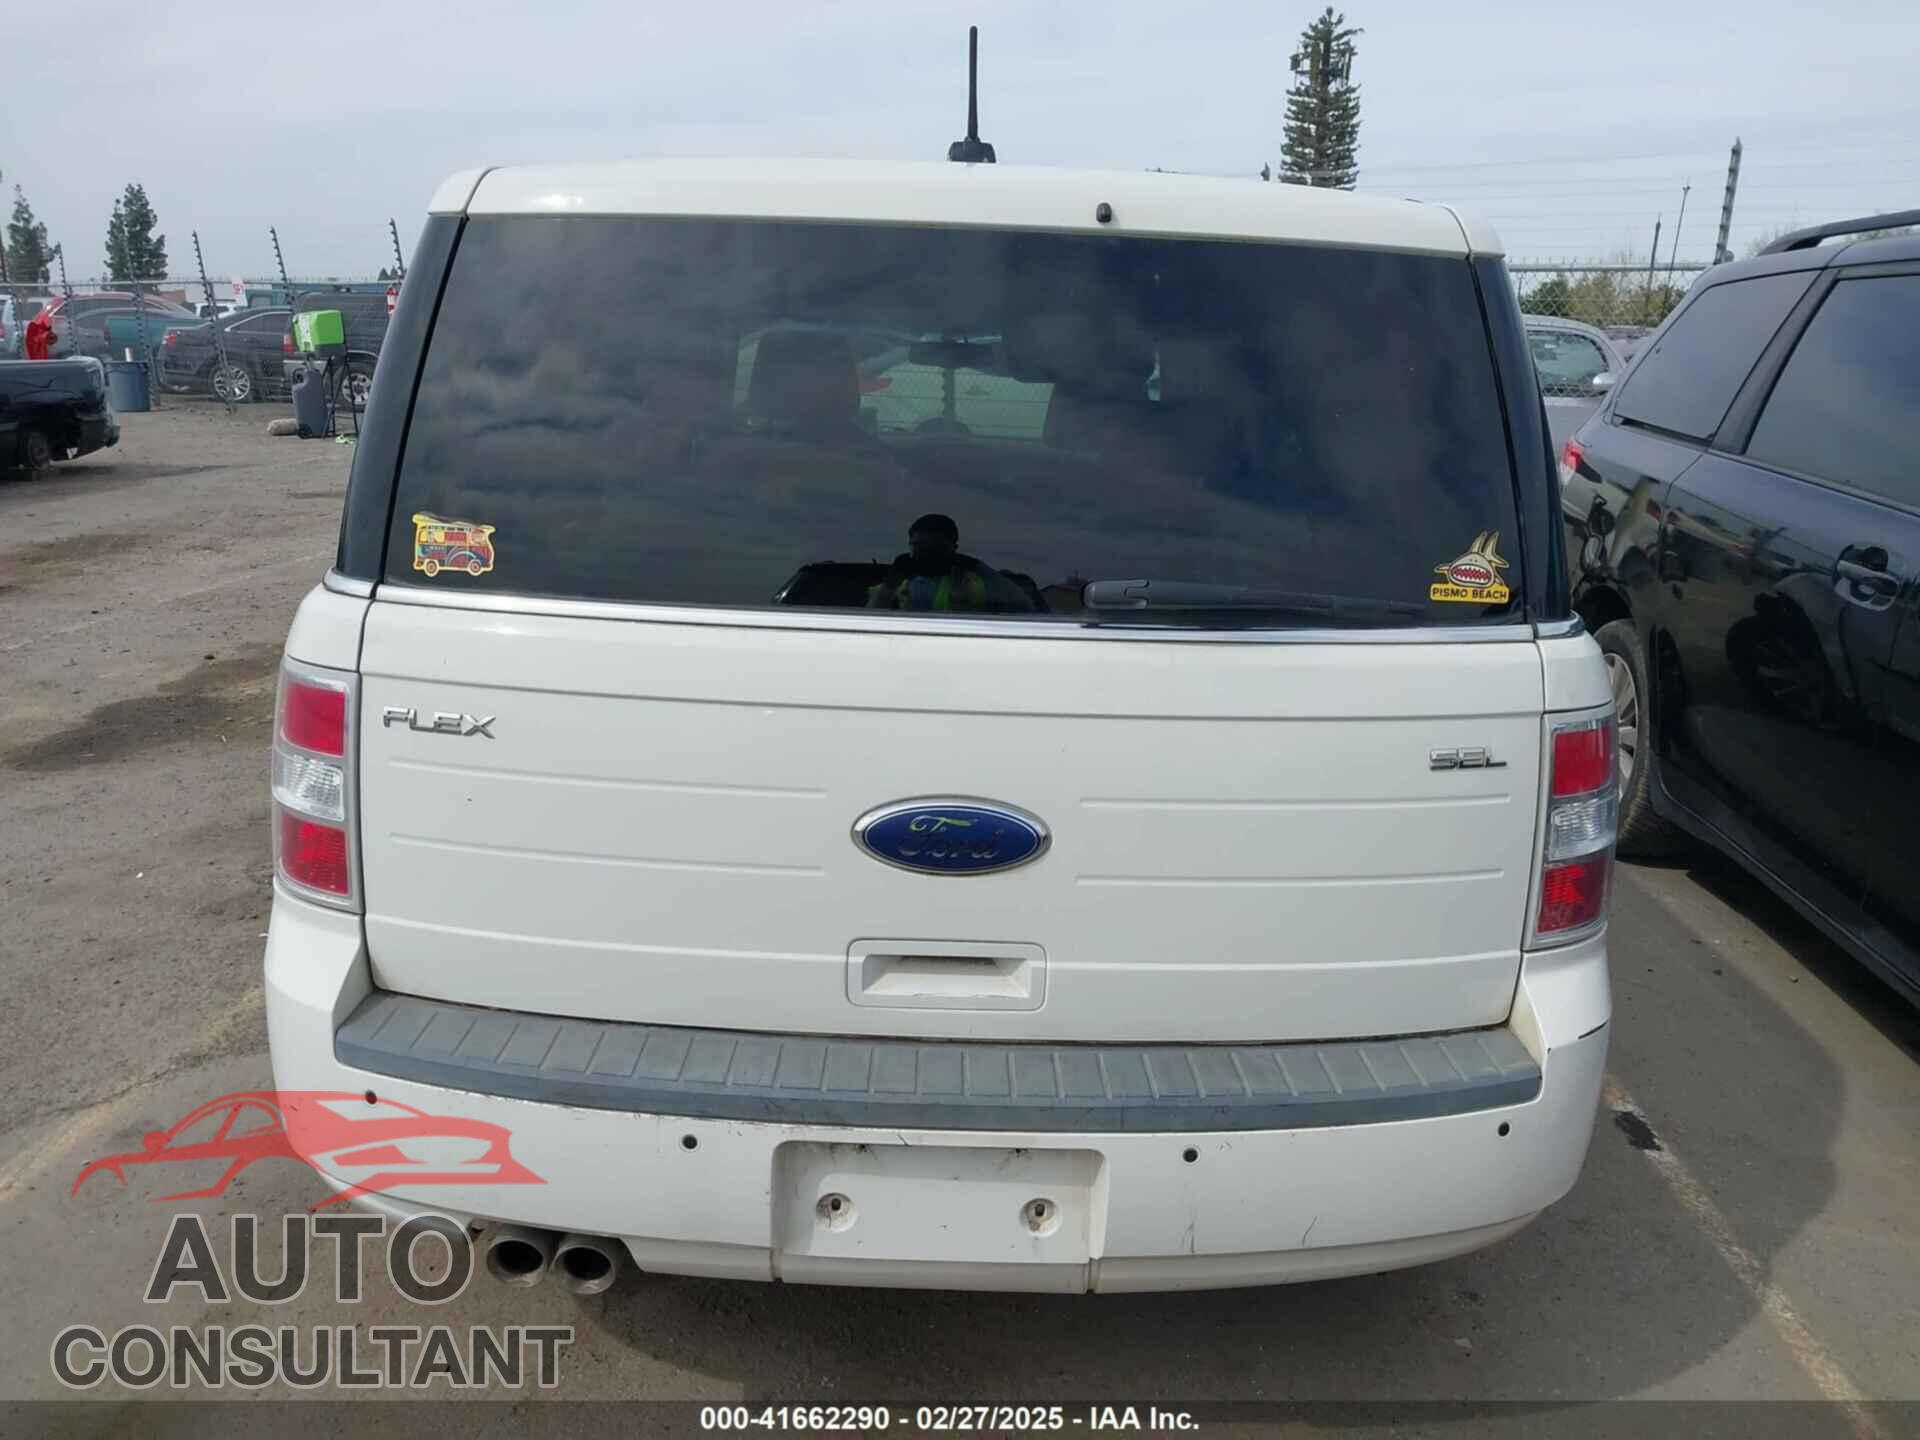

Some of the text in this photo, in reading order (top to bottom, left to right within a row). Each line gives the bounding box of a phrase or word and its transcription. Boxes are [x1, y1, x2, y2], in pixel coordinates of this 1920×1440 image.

[1432, 587, 1507, 599] PISMO BEACH
[383, 705, 496, 739] FLEX
[1429, 746, 1507, 771] SEL
